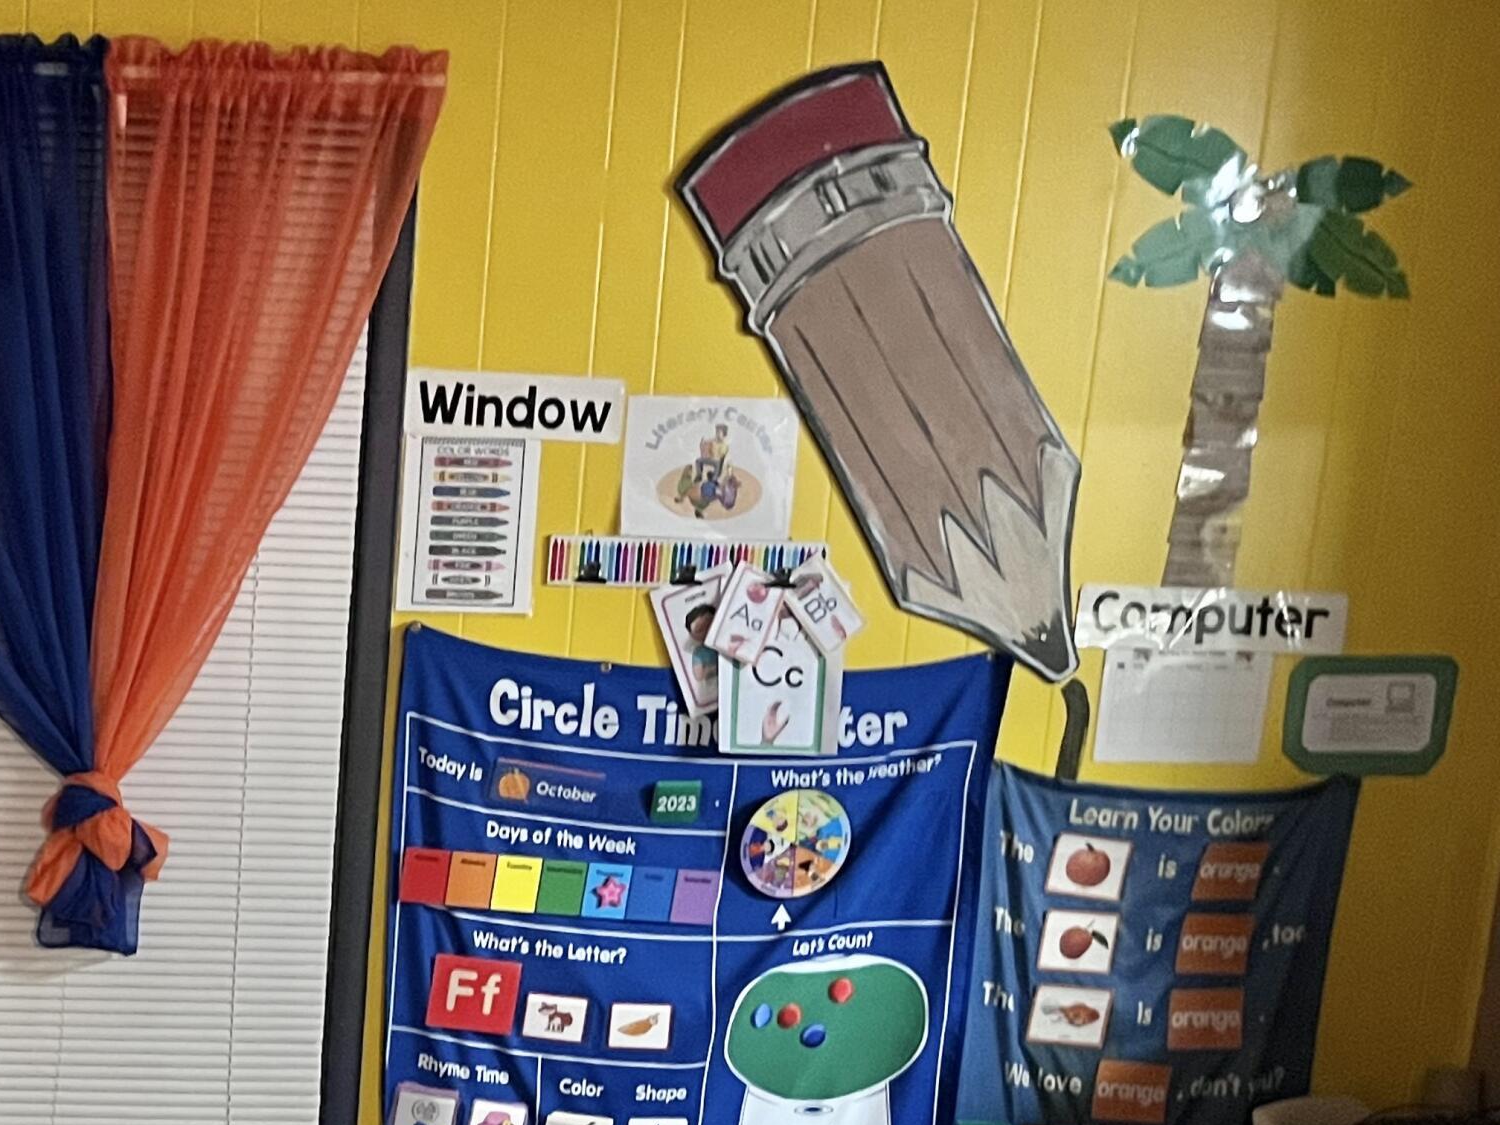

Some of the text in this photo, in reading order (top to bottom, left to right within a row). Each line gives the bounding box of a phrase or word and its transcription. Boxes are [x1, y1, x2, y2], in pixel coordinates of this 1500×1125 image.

[419, 379, 613, 435] Window
[437, 445, 510, 457] COLOR WORDS
[730, 604, 763, 632] Aa
[803, 592, 838, 624] Bb
[1092, 589, 1331, 645] Computer
[752, 646, 804, 687] Cc
[490, 678, 908, 748] Circle Tim ter
[418, 746, 466, 781] Today
[771, 768, 831, 788] What's
[836, 767, 865, 786] the
[537, 780, 597, 804] October
[656, 795, 697, 813] 2023
[1068, 798, 1274, 836] Learn Your Colors
[486, 820, 638, 856] Days of the Week
[1000, 830, 1261, 883] The is orange
[472, 930, 628, 965] What's the Letter?
[792, 930, 874, 957] Let's Count
[994, 906, 1026, 937] The
[1146, 928, 1164, 952] is
[1182, 934, 1248, 959] orange
[446, 968, 503, 1016] Ff
[982, 981, 1015, 1013] The
[1171, 1010, 1241, 1032] orange
[418, 1053, 510, 1086] Rhyme Time
[1004, 1061, 1031, 1087] We
[1037, 1064, 1083, 1095] love
[1097, 1083, 1166, 1106] orange
[559, 1077, 688, 1105] Color Shape
